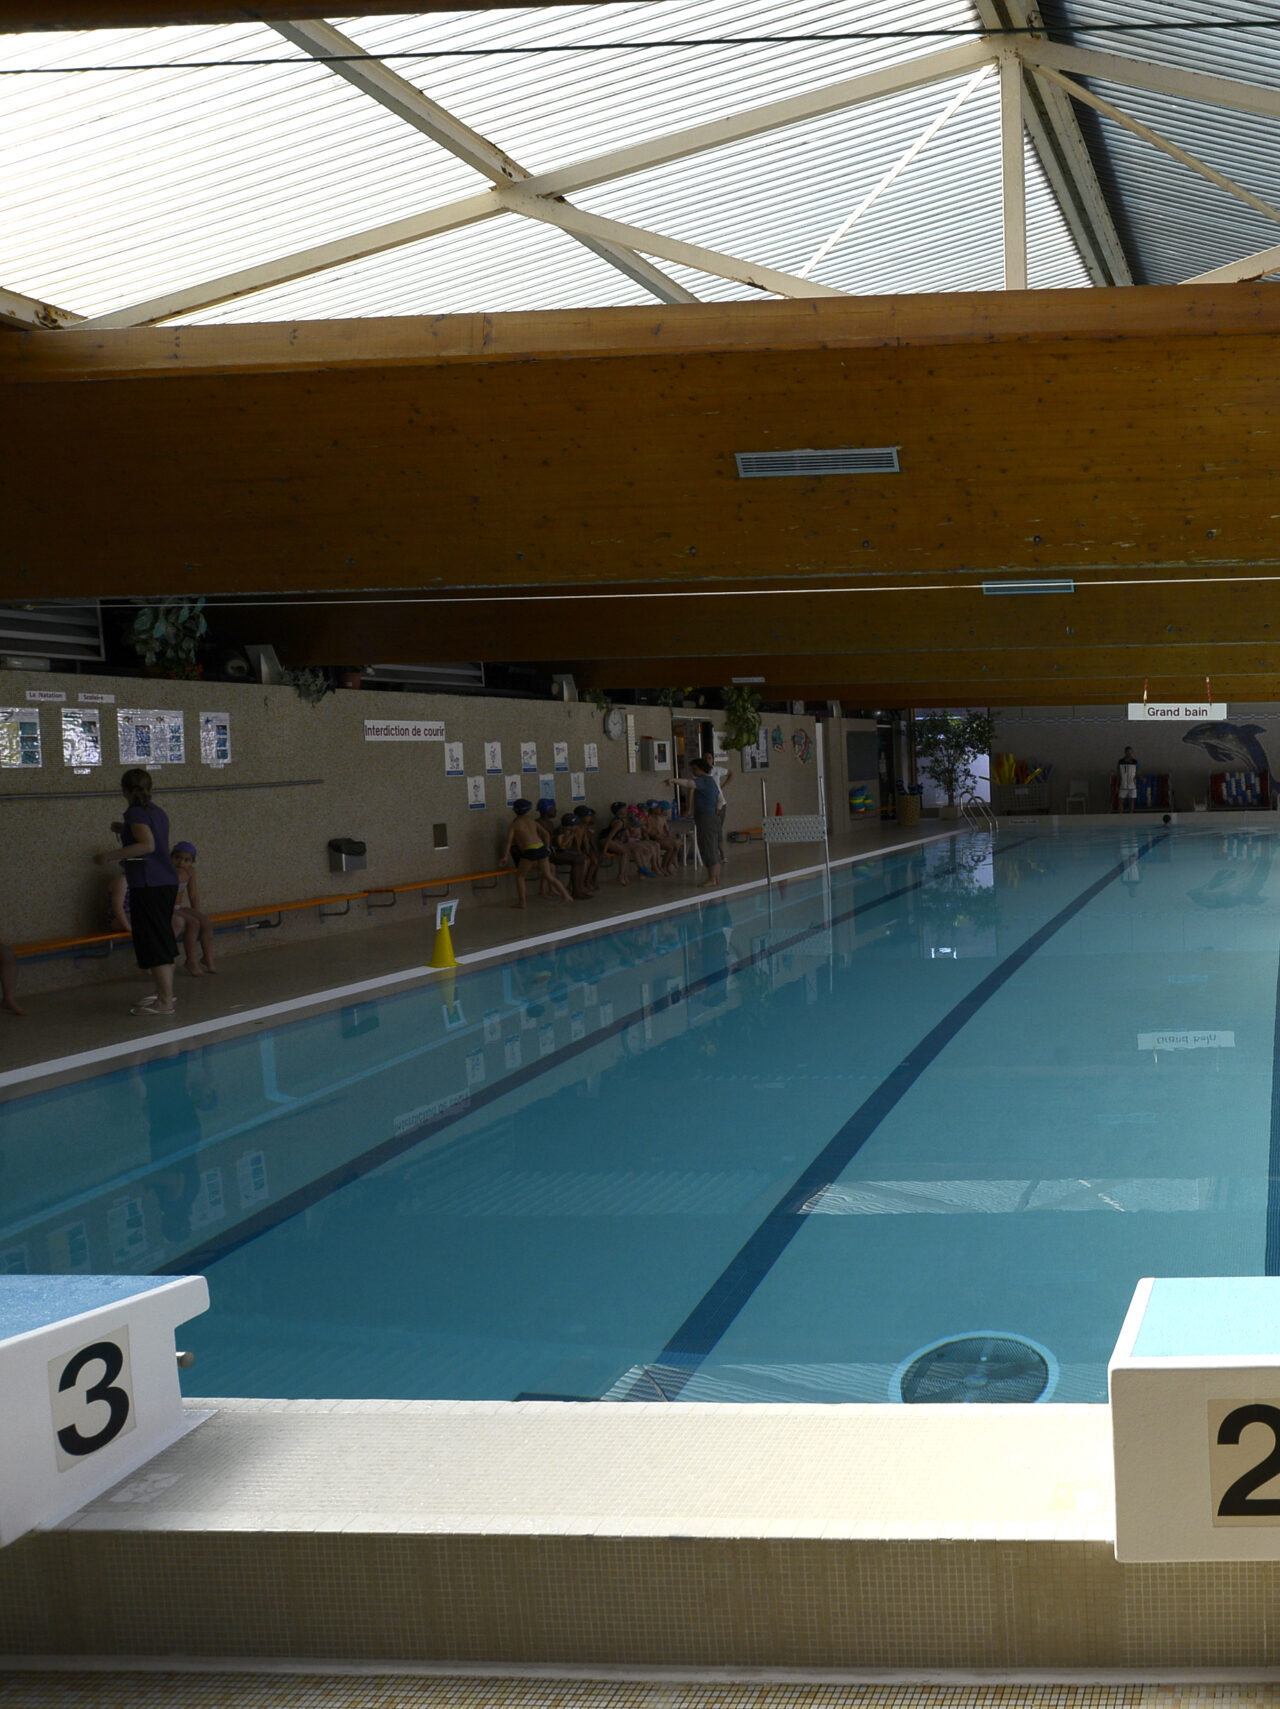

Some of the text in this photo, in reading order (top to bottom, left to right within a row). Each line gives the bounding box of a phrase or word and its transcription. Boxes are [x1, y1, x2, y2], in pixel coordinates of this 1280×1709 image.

[1147, 707, 1208, 717] Grand bain
[365, 724, 444, 737] Interdiction de courir
[57, 1340, 131, 1457] 3
